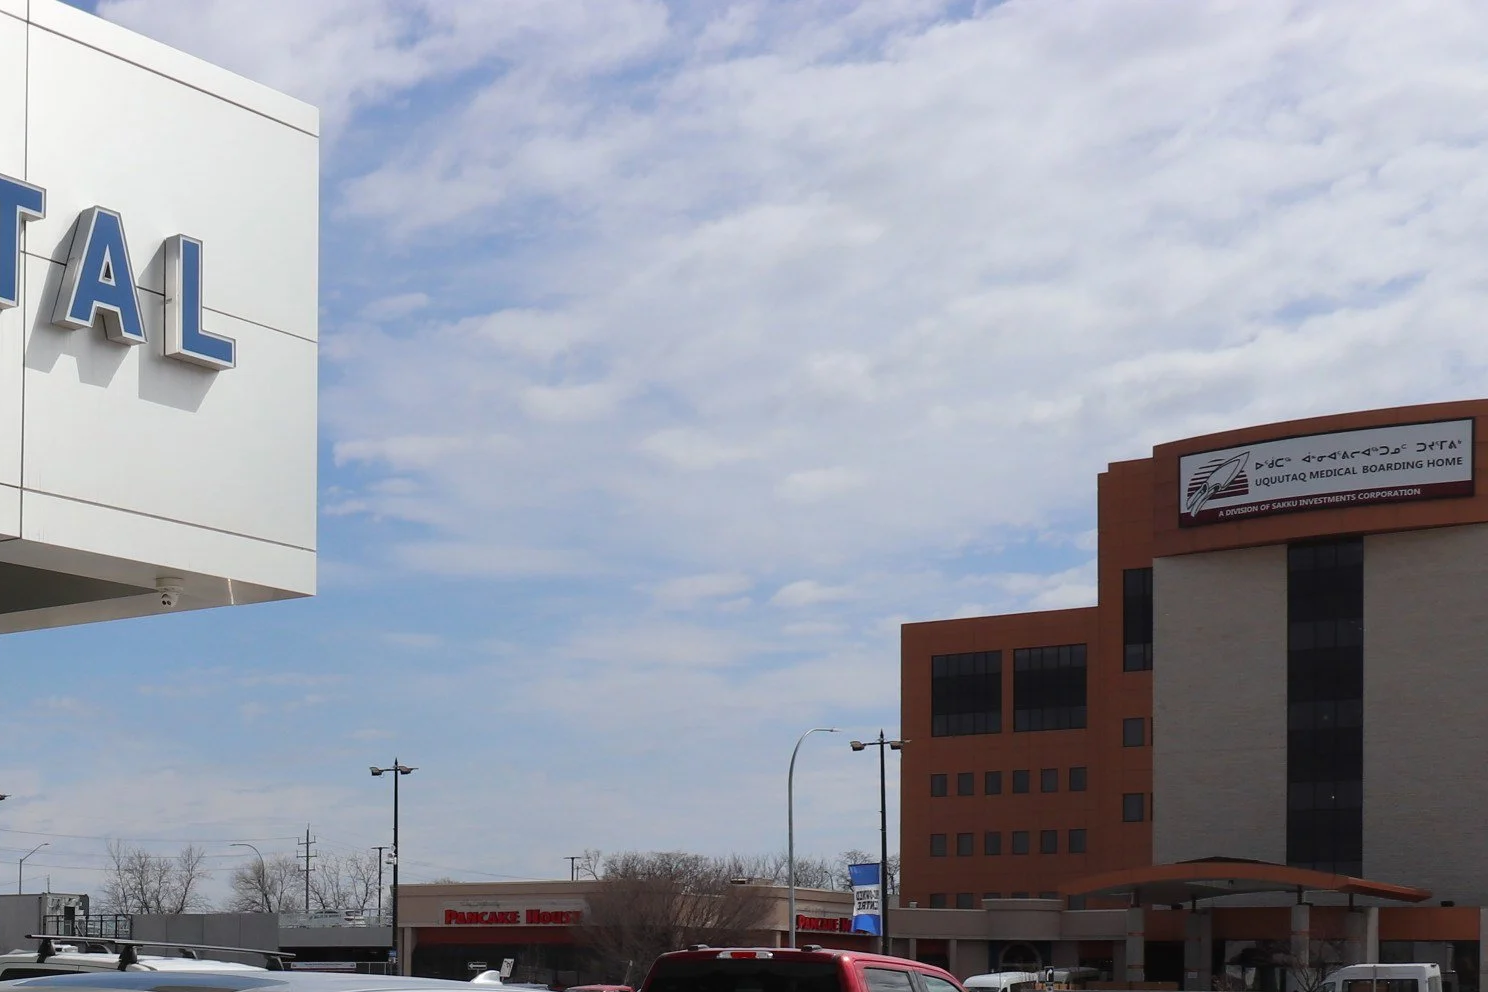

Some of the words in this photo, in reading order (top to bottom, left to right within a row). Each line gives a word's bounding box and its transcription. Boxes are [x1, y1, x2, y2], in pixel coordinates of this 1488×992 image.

[1255, 472, 1307, 487] UQUUTAQ
[1309, 466, 1358, 480] MEDICAL
[1362, 459, 1424, 474] BOARDING
[1427, 456, 1464, 469] HOME
[1218, 510, 1225, 518] A
[1225, 506, 1259, 517] DIVISION
[1260, 503, 1270, 512] OF
[1271, 500, 1298, 510] SAKKU
[1299, 493, 1357, 507] INVESTMENTS
[1358, 487, 1422, 501] CORPORATION
[444, 909, 521, 925] PANCAKE
